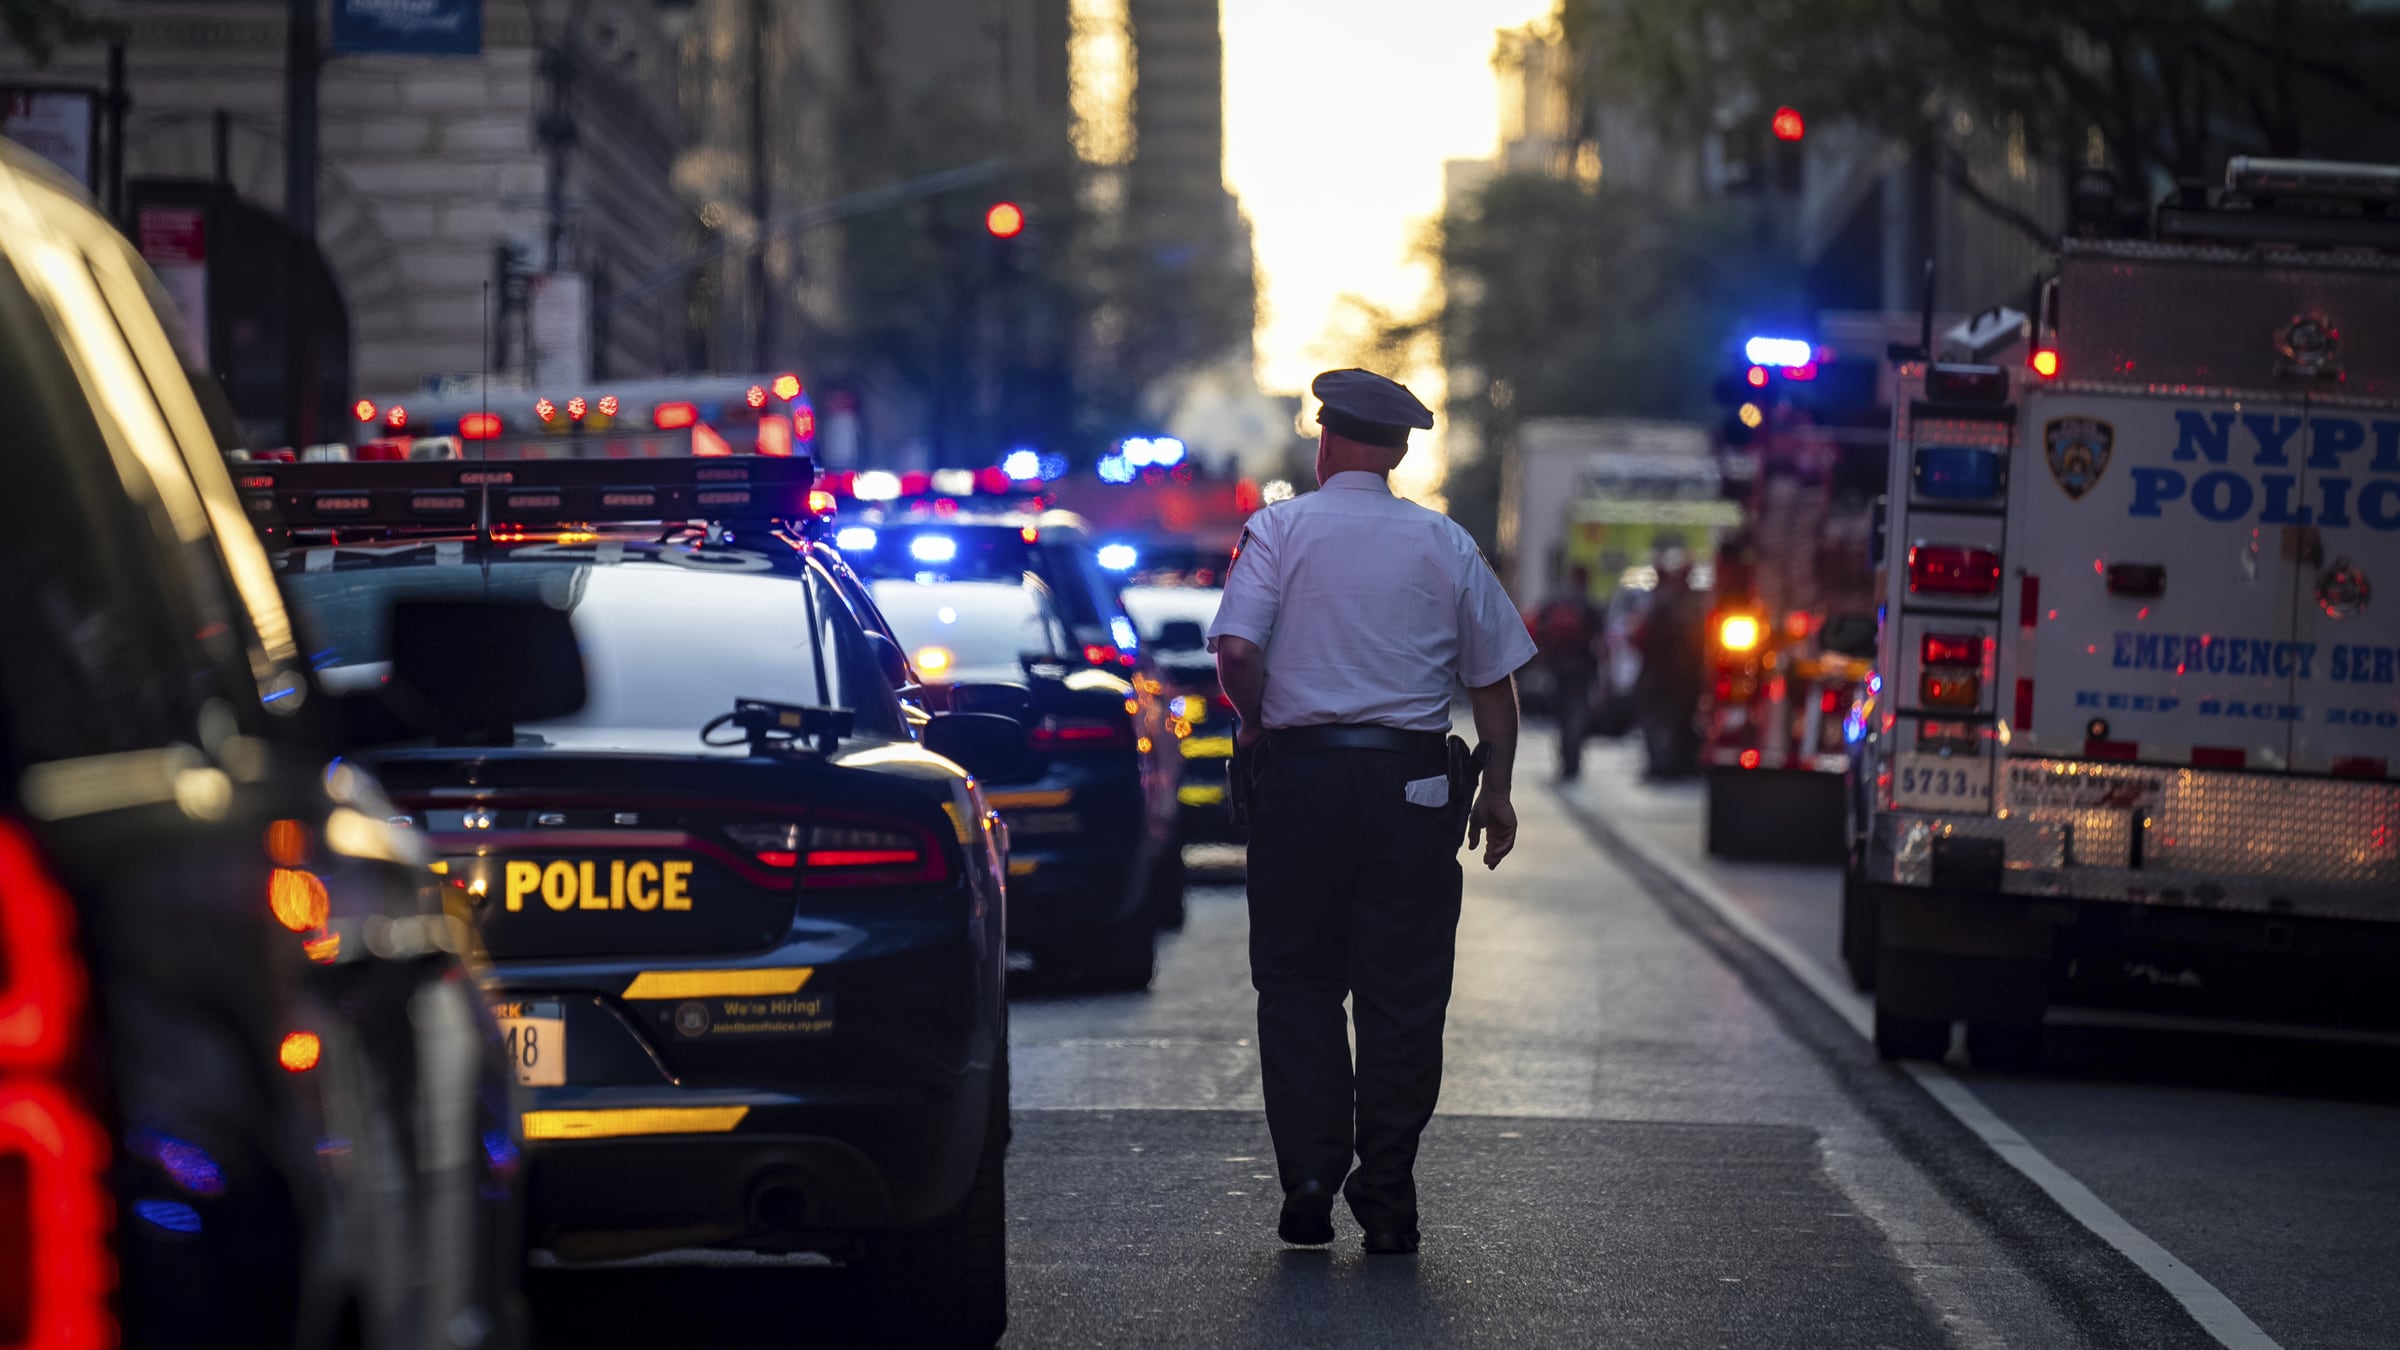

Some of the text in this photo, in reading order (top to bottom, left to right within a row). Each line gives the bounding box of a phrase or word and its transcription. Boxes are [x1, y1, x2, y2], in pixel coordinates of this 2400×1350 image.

[2112, 632, 2400, 684] EMERGENCY SER
[2075, 690, 2179, 712] KEEP
[2199, 700, 2304, 722] BACK
[1903, 767, 1967, 796] 5733
[505, 860, 694, 912] POLICE
[724, 999, 821, 1016] We're Hiring!
[506, 1026, 538, 1068] 48
